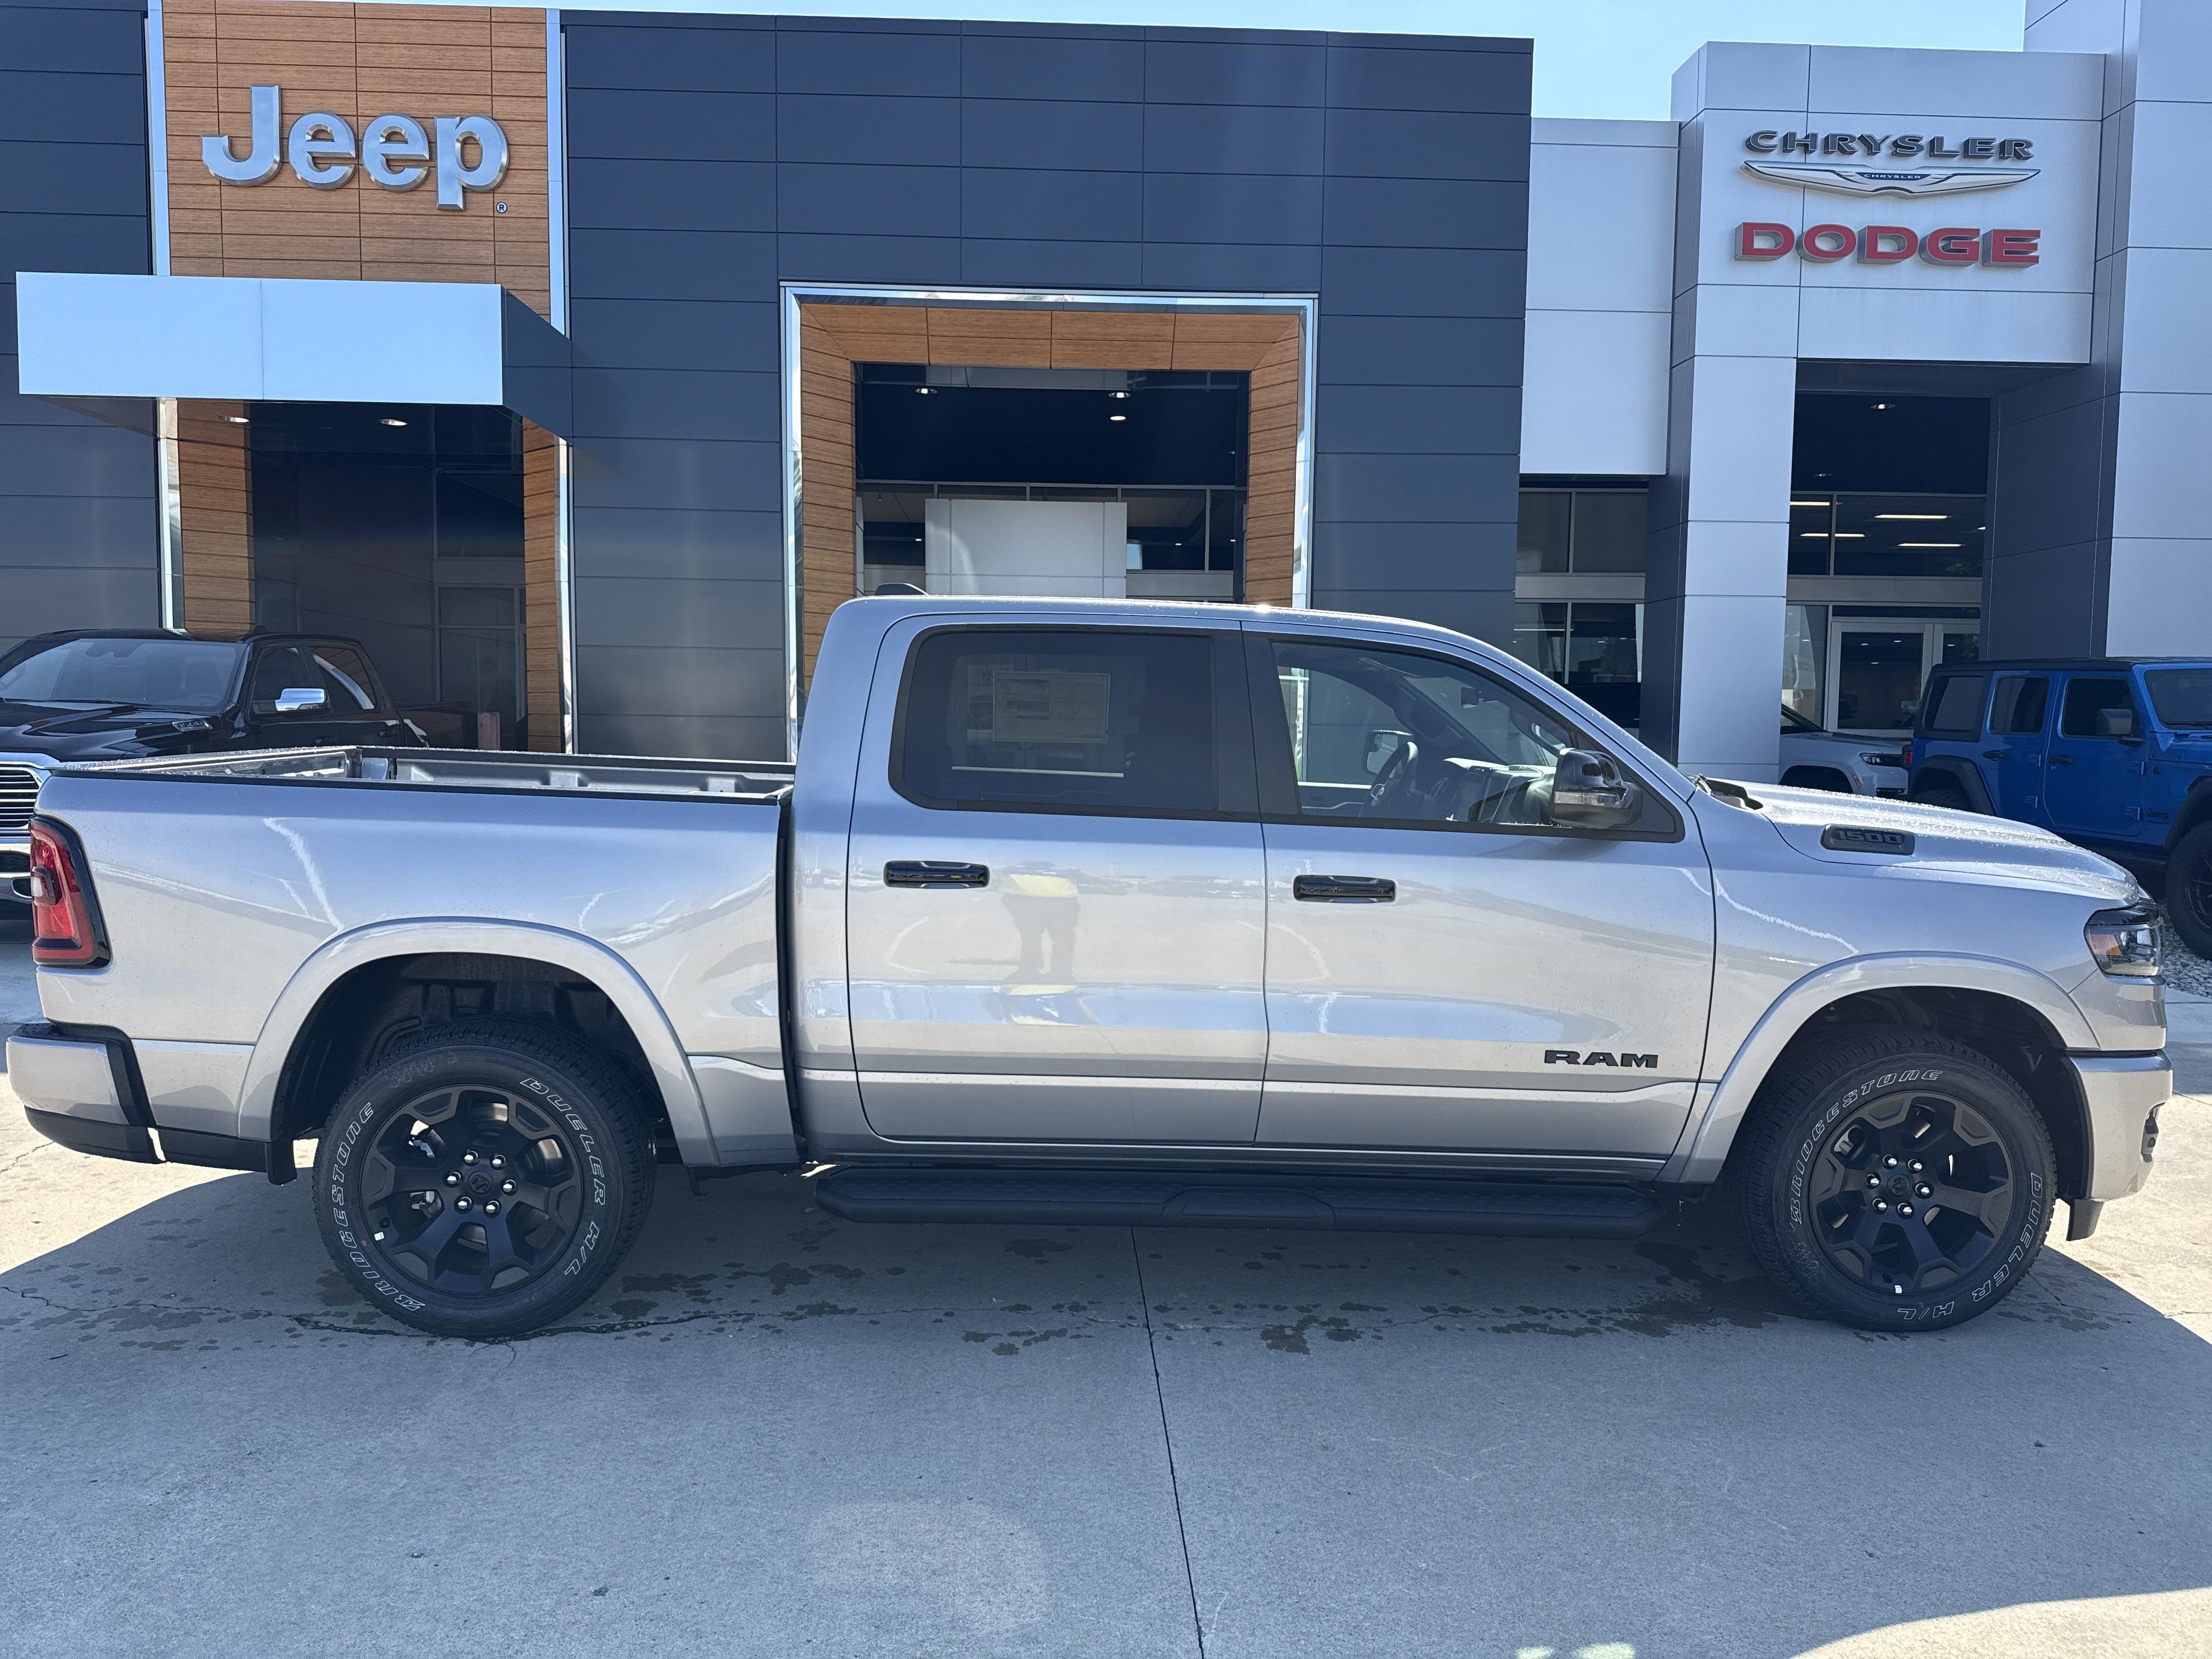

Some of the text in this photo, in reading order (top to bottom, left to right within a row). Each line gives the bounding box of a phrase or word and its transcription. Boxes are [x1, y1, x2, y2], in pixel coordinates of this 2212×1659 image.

[201, 84, 509, 211] Jeep
[1745, 130, 2034, 160] CHRYSLER
[1735, 222, 2041, 268] DODGE
[1831, 830, 1903, 844] 1500
[1544, 1049, 1658, 1068] RAM
[332, 1102, 426, 1311] BRIDGESTONE
[521, 1078, 606, 1277] DUELER H/L
[1791, 1069, 1943, 1224] BRIDGESTONE
[1897, 1172, 2042, 1321] DUELER H/L
